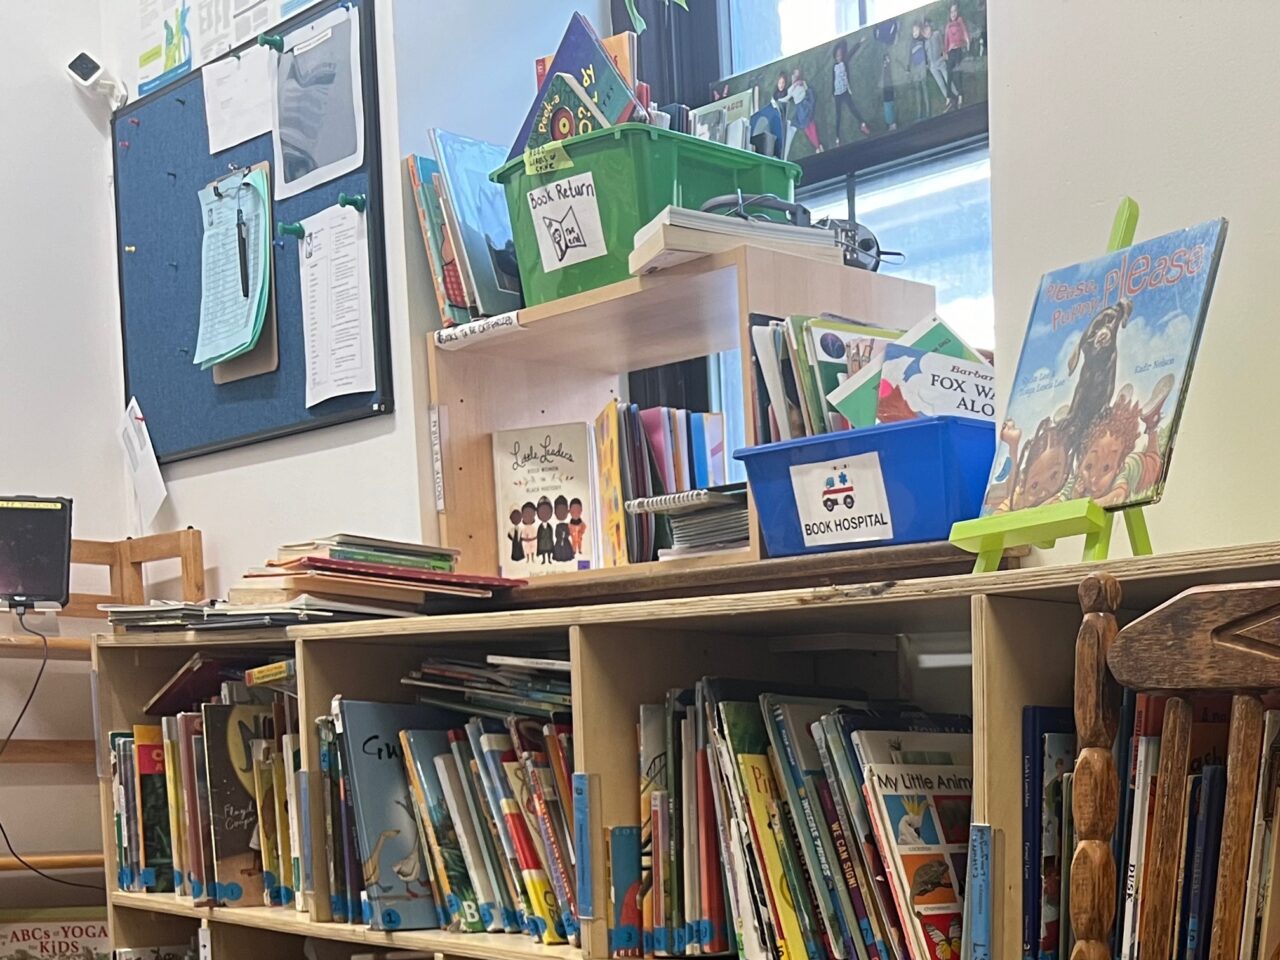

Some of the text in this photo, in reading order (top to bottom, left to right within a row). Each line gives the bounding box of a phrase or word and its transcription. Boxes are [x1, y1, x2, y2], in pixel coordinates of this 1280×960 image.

[538, 94, 560, 132] Peek-a
[529, 181, 595, 210] Book Return
[1104, 244, 1206, 307] Please
[931, 373, 967, 394] FOX
[950, 365, 995, 382] Barbar
[956, 396, 995, 417] ALO
[804, 512, 889, 537] BOOK HOSPITAL
[877, 772, 973, 793] My Little Anim
[801, 797, 831, 878] INVISIBLE THINGS
[831, 822, 858, 889] WE CAN SIGN!
[1126, 863, 1137, 902] DUSK
[10, 927, 51, 943] ABCs
[60, 925, 109, 939] YOGA
